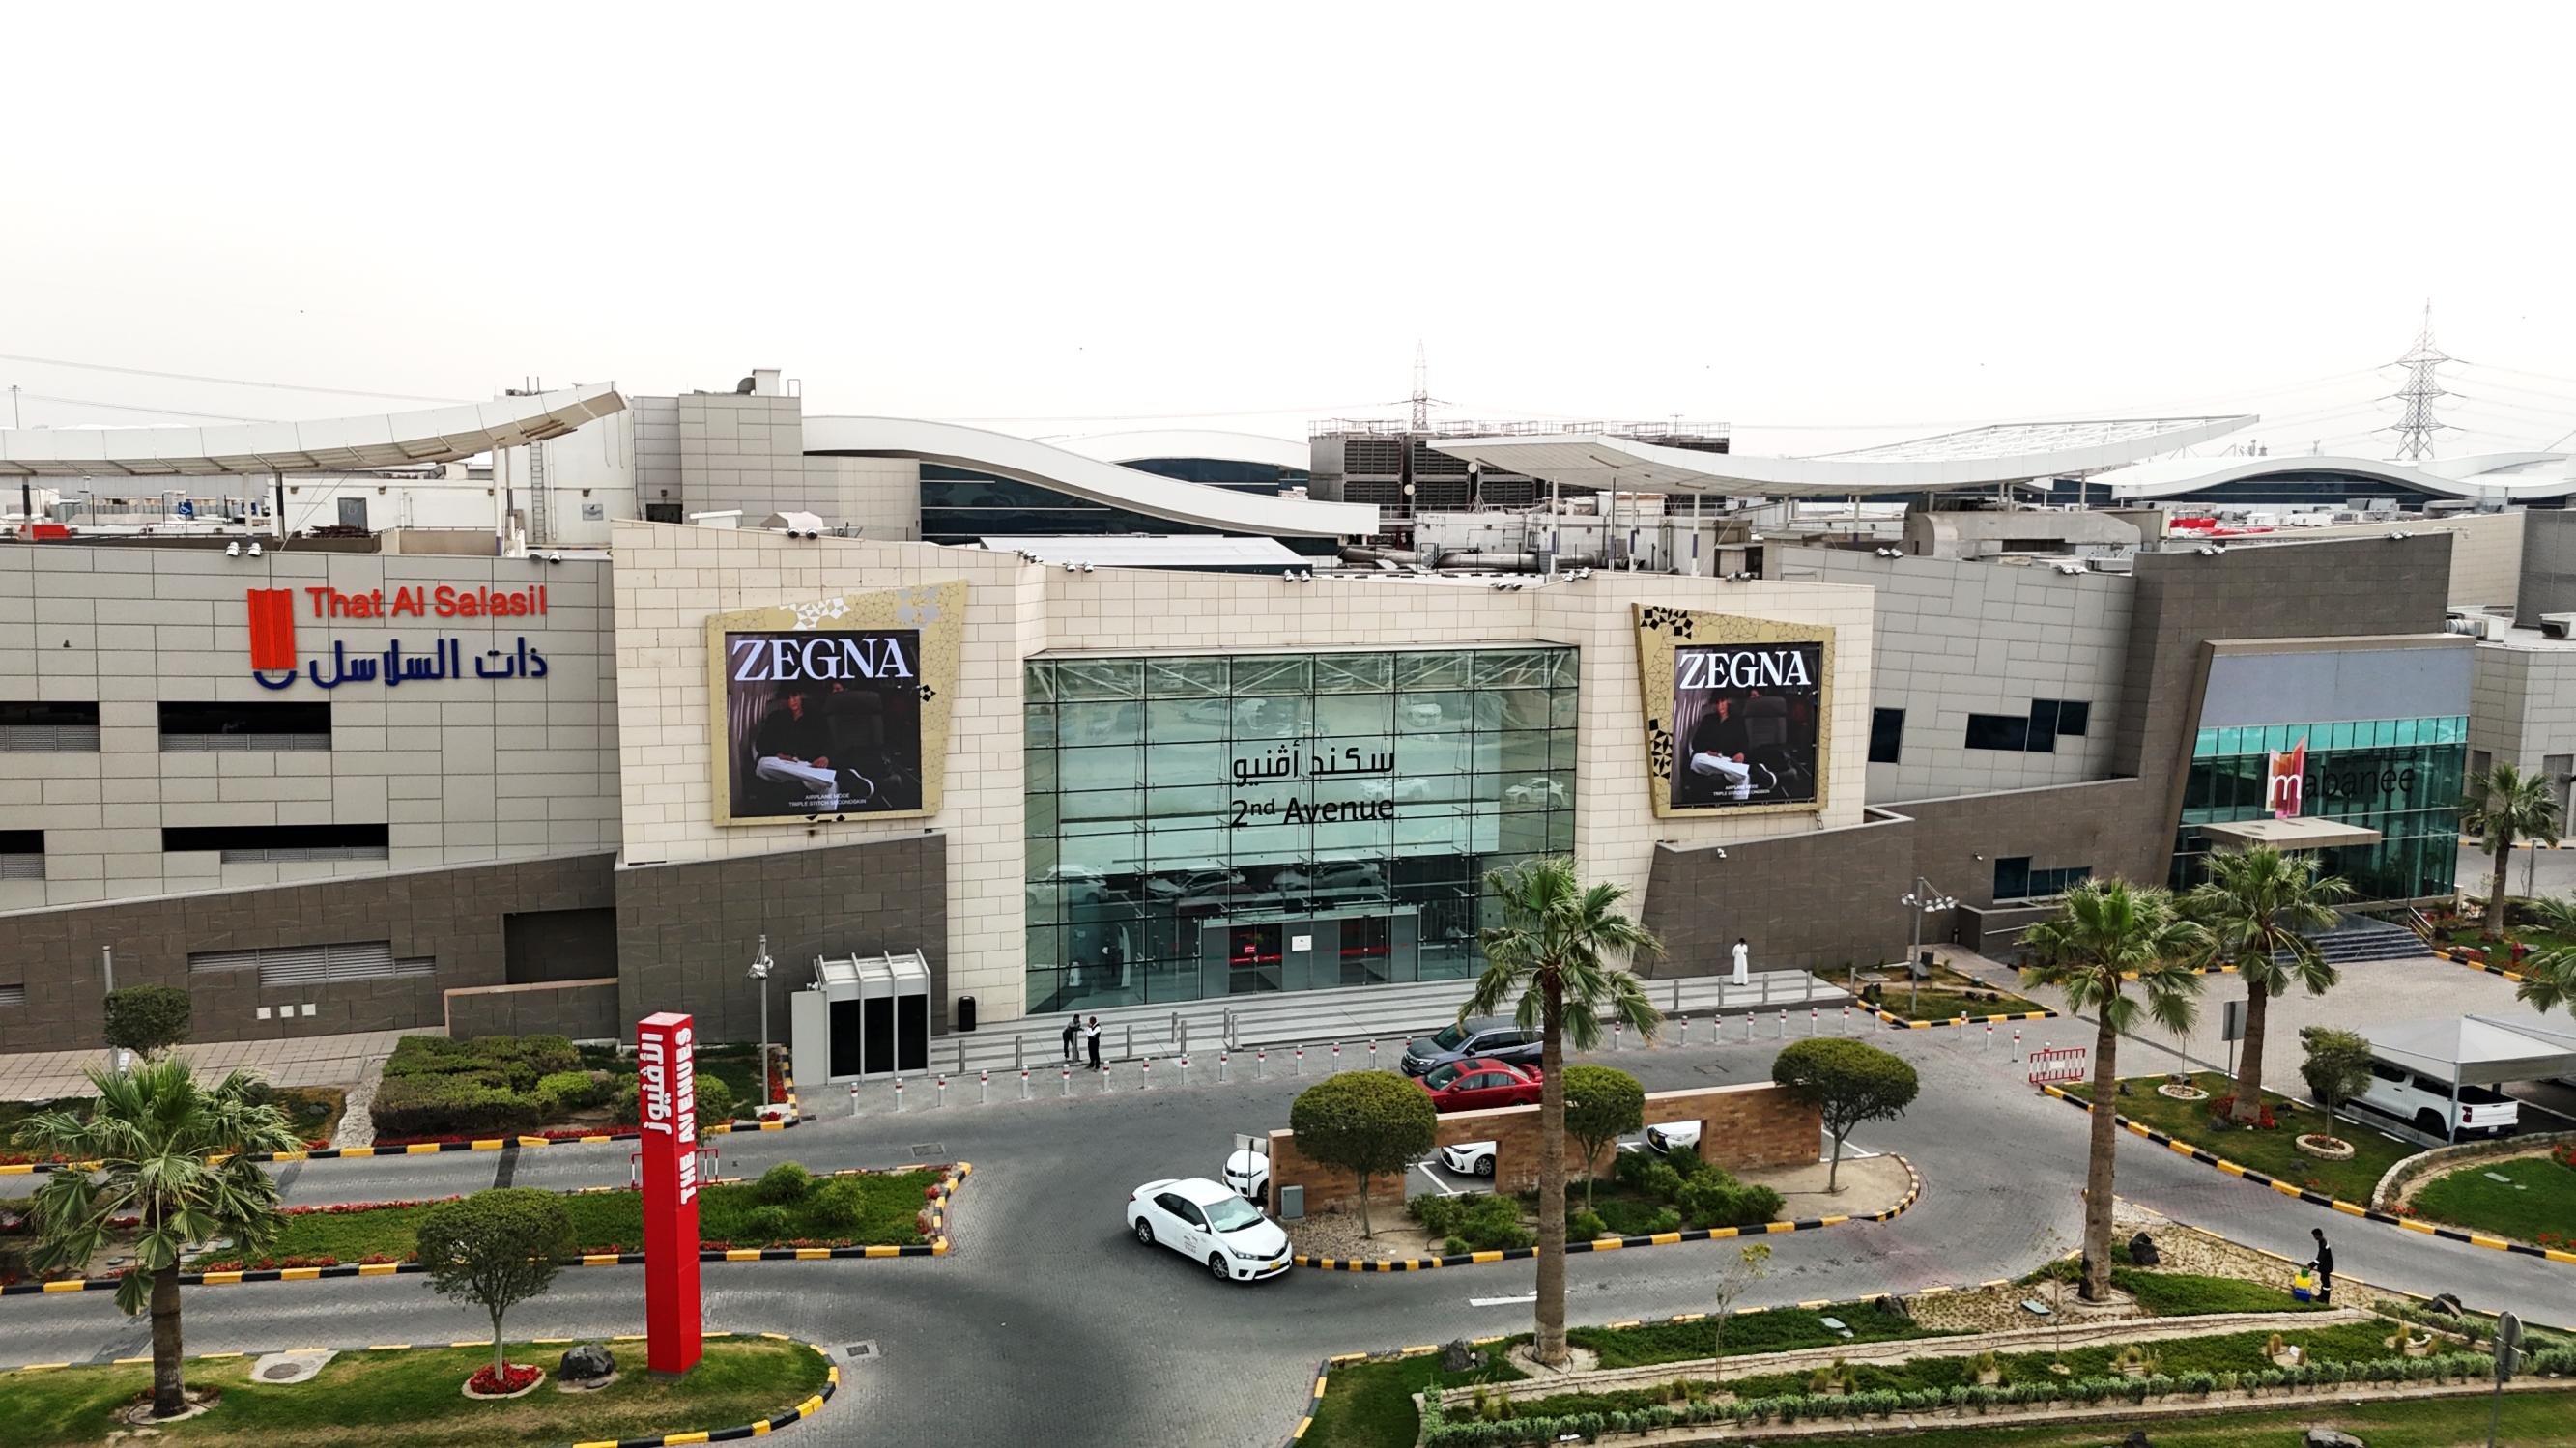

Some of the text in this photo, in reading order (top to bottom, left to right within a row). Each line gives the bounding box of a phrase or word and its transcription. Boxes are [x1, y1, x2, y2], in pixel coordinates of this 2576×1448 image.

[305, 585, 548, 618] That Al Salasil
[309, 637, 548, 689] ذات السلاسل
[732, 638, 914, 681] ZEGNA
[1678, 650, 1812, 689] ZEGNA
[1309, 747, 1394, 775] سكند
[2270, 766, 2416, 801] mabanee
[1231, 797, 1394, 826] 2nd Avenue
[675, 1027, 697, 1205] THE AVENUES
